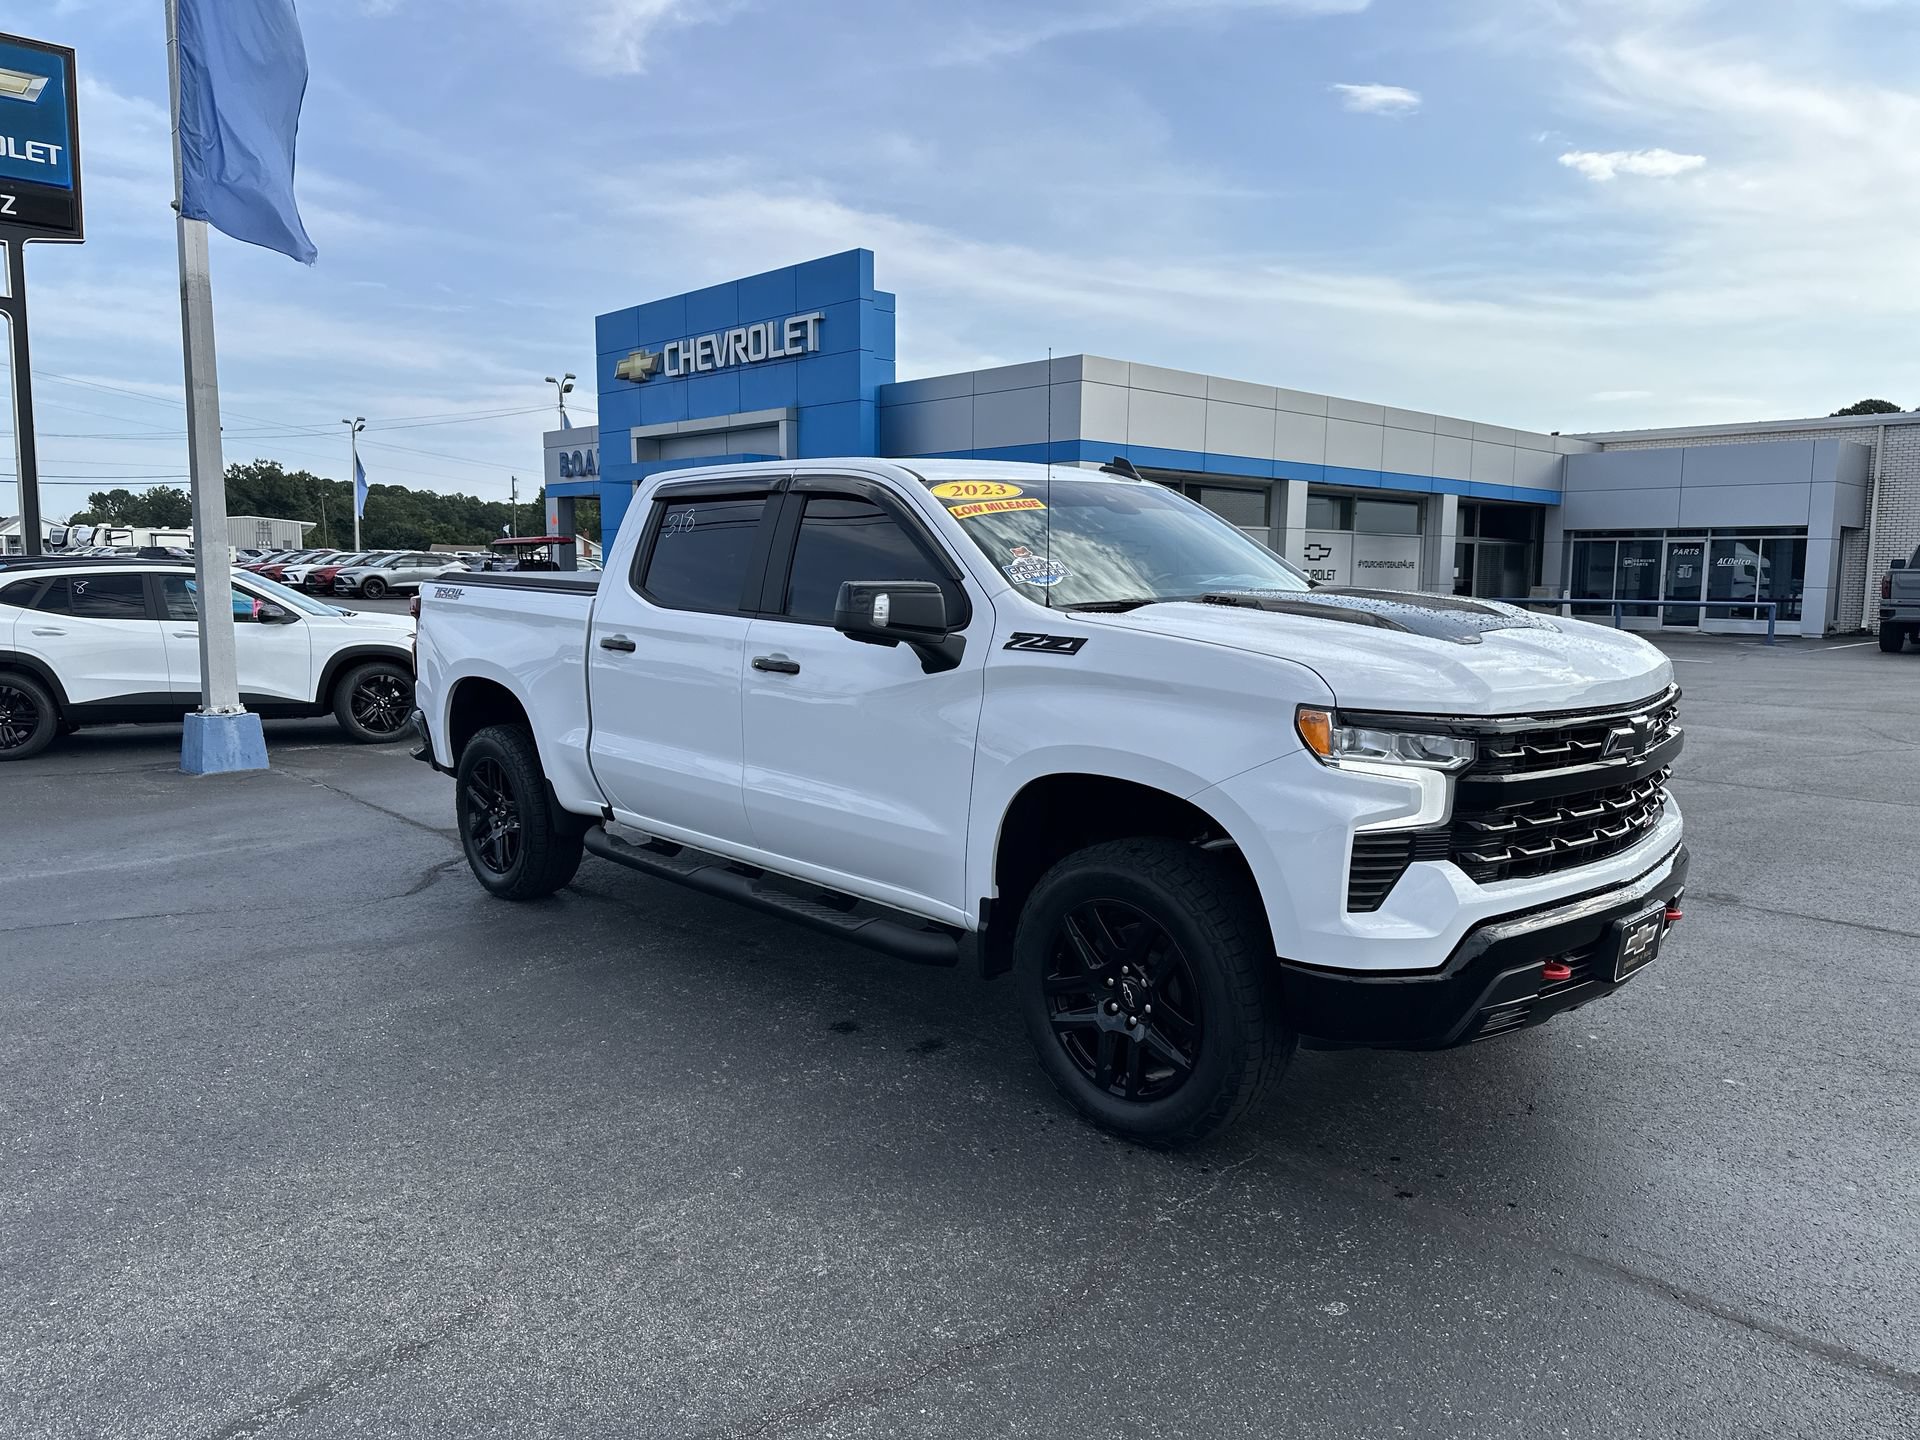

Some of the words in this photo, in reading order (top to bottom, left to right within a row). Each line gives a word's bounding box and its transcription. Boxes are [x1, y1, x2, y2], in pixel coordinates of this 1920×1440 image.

[664, 311, 823, 377] CHEVROLET
[559, 449, 600, 477] BOA
[949, 484, 1007, 497] 2023
[952, 506, 983, 517] LOW
[985, 500, 1041, 511] MILEAGE
[1009, 561, 1064, 574] CARFAX
[1716, 557, 1752, 566] ACDelco
[1023, 568, 1067, 579] OWNER
[434, 586, 465, 595] TRAIL
